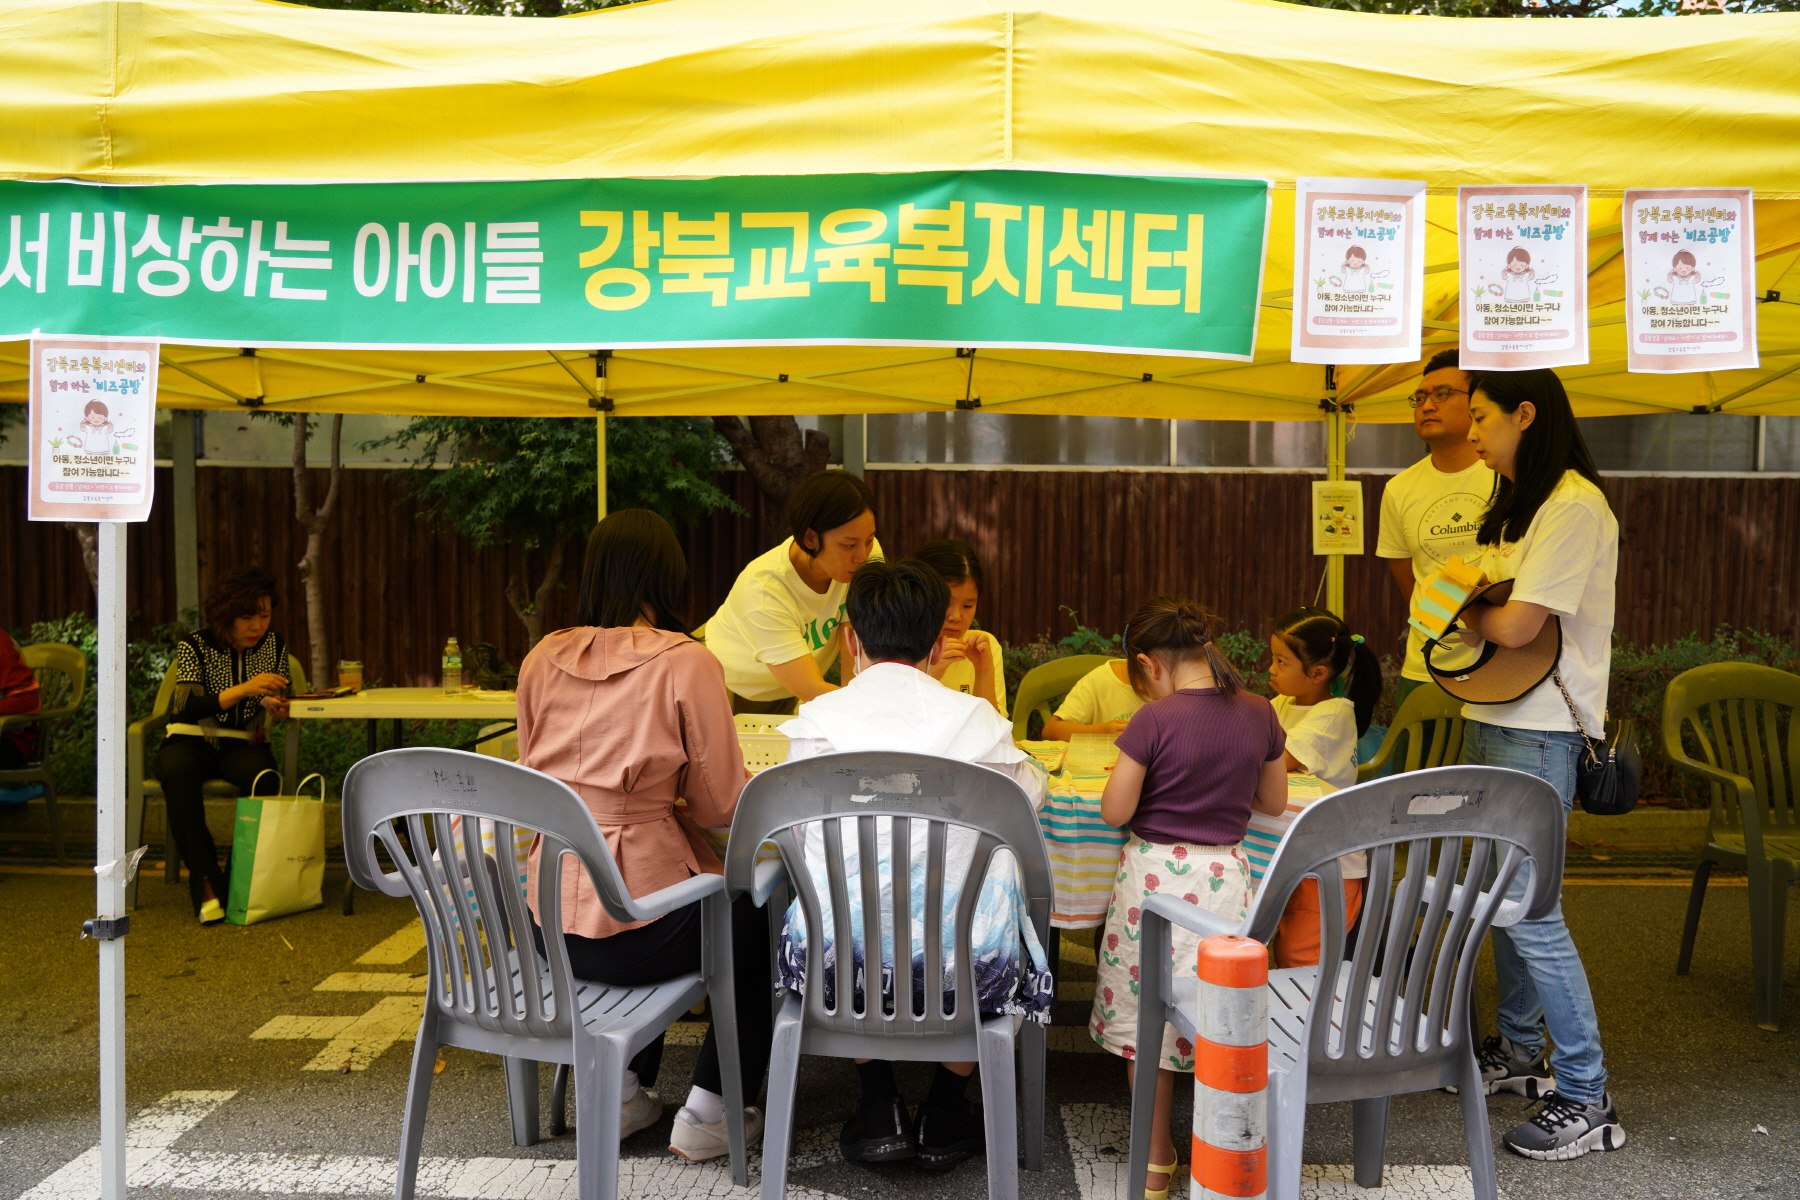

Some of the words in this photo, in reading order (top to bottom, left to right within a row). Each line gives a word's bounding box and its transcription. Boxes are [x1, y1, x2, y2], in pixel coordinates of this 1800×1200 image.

[1317, 206, 1402, 223] 강북교육복지센터와
[1472, 203, 1571, 220] 강북교육복지센터와
[1638, 206, 1736, 224] 강북교육복지센터와
[1318, 227, 1334, 238] 함께
[1336, 228, 1352, 239] 하는
[1474, 227, 1492, 240] 함께
[1495, 227, 1514, 240] 하는
[1639, 230, 1658, 243] 함께
[1661, 230, 1680, 243] 하는
[67, 211, 332, 301] 비상하는
[352, 221, 543, 304] 아이들
[578, 200, 1204, 313] 강북교육복지센터
[1334, 293, 1369, 302] 청소년이면
[1370, 294, 1391, 302] 누구나
[1324, 304, 1339, 312] 참여
[1494, 303, 1534, 313] 청소년이면
[1535, 303, 1560, 311] 누구나
[1660, 306, 1700, 315] 청소년이면
[1702, 305, 1728, 314] 누구나
[1484, 316, 1499, 325] 참여
[1650, 319, 1666, 328] 참여
[46, 355, 146, 374] 강북교육복지센터와
[49, 380, 68, 392] 함께
[71, 380, 90, 393] 하는
[74, 455, 113, 465] 청소년이면
[115, 456, 136, 465] 누구나
[63, 467, 79, 476] 참여
